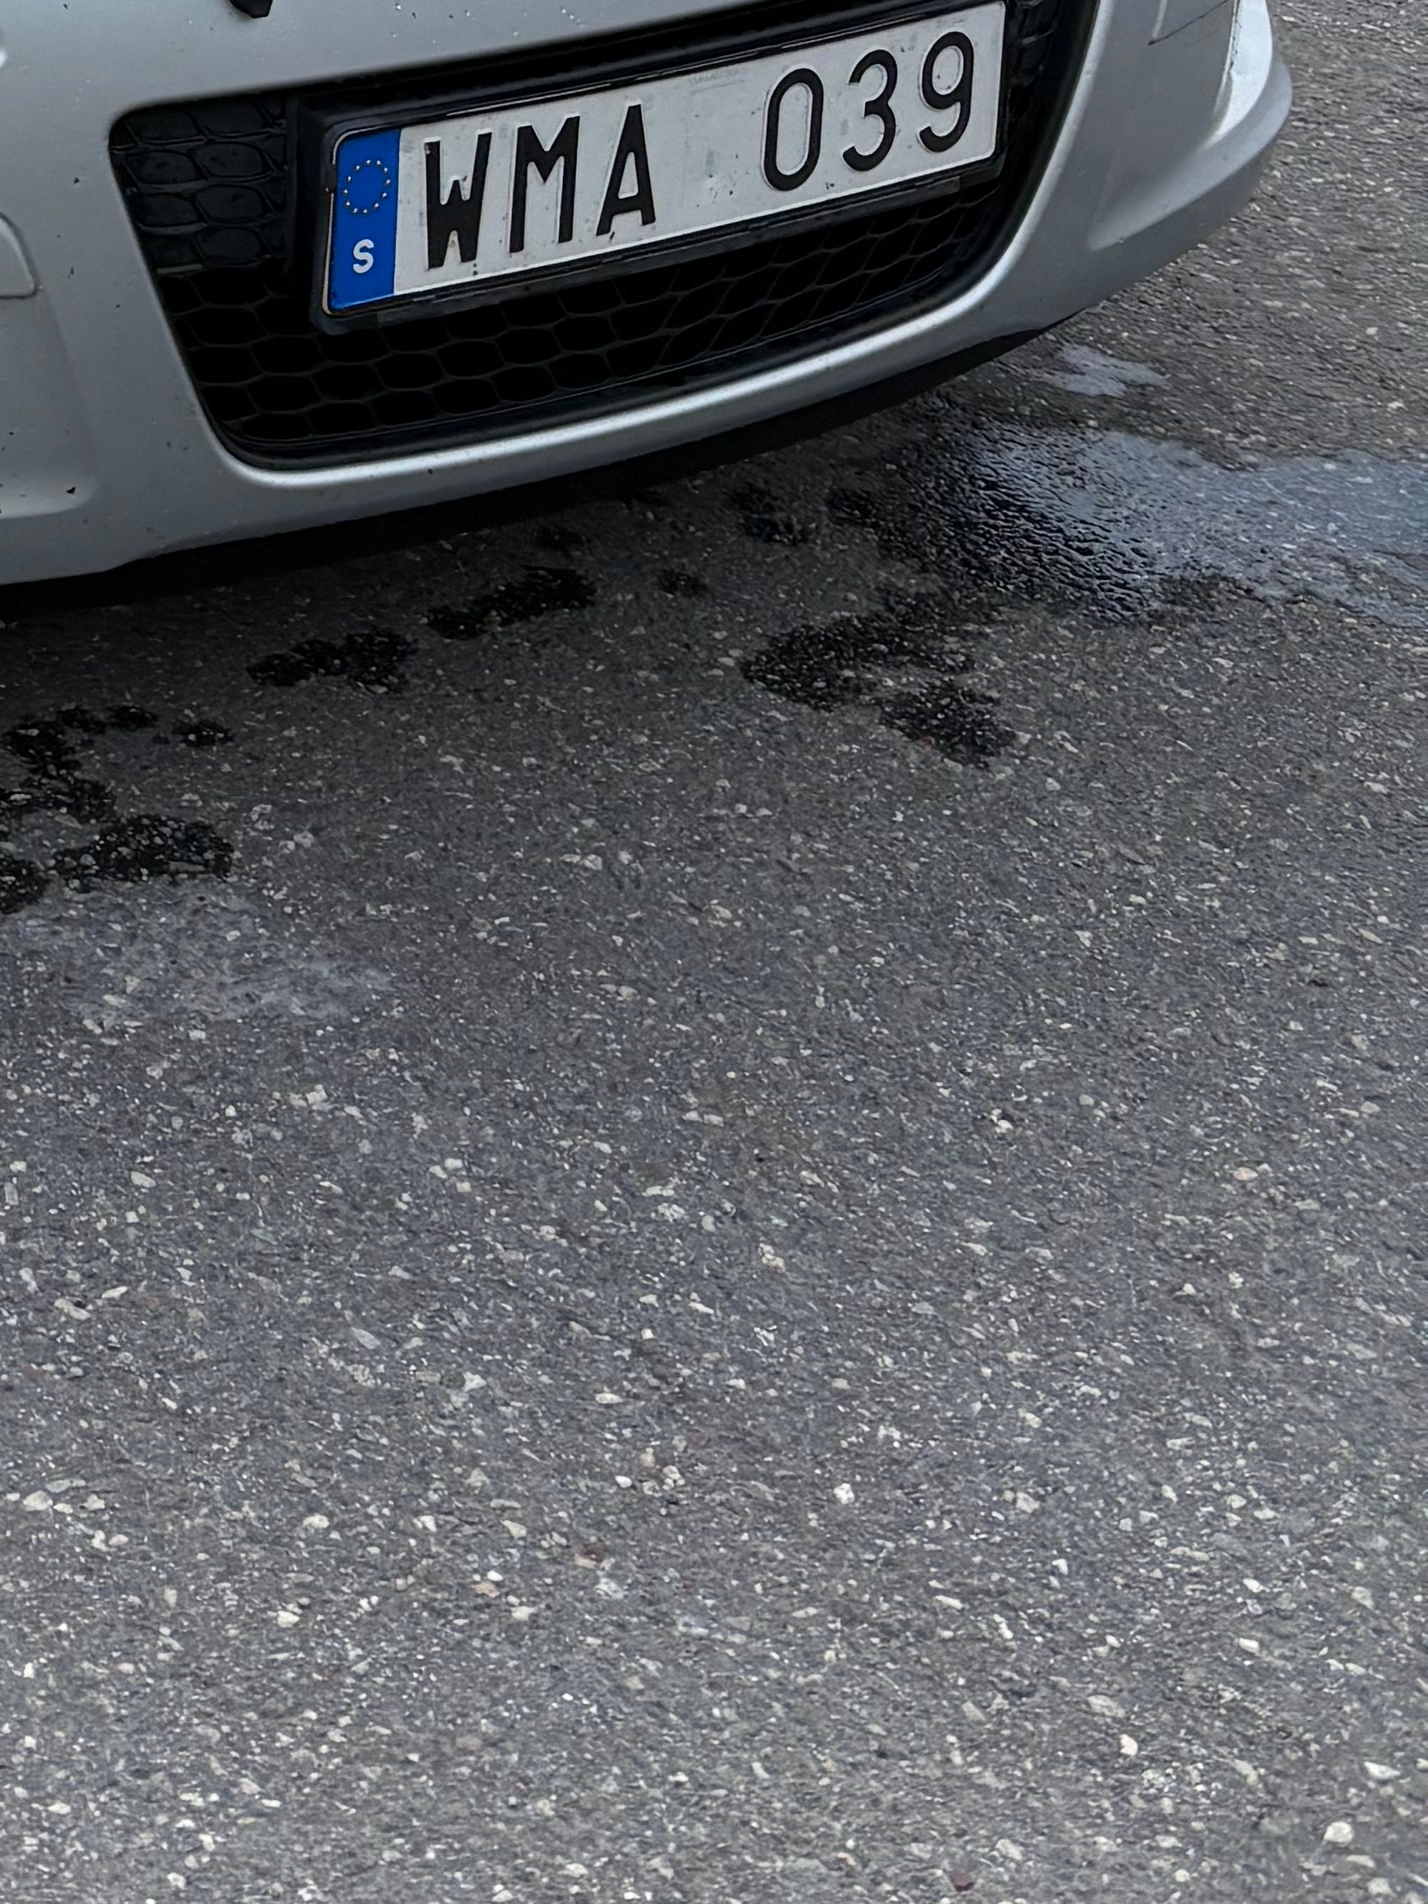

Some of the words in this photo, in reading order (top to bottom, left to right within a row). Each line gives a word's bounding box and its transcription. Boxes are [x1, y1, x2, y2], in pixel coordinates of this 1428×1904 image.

[424, 103, 657, 270] WMA
[762, 31, 976, 193] 039
[351, 238, 376, 275] S
